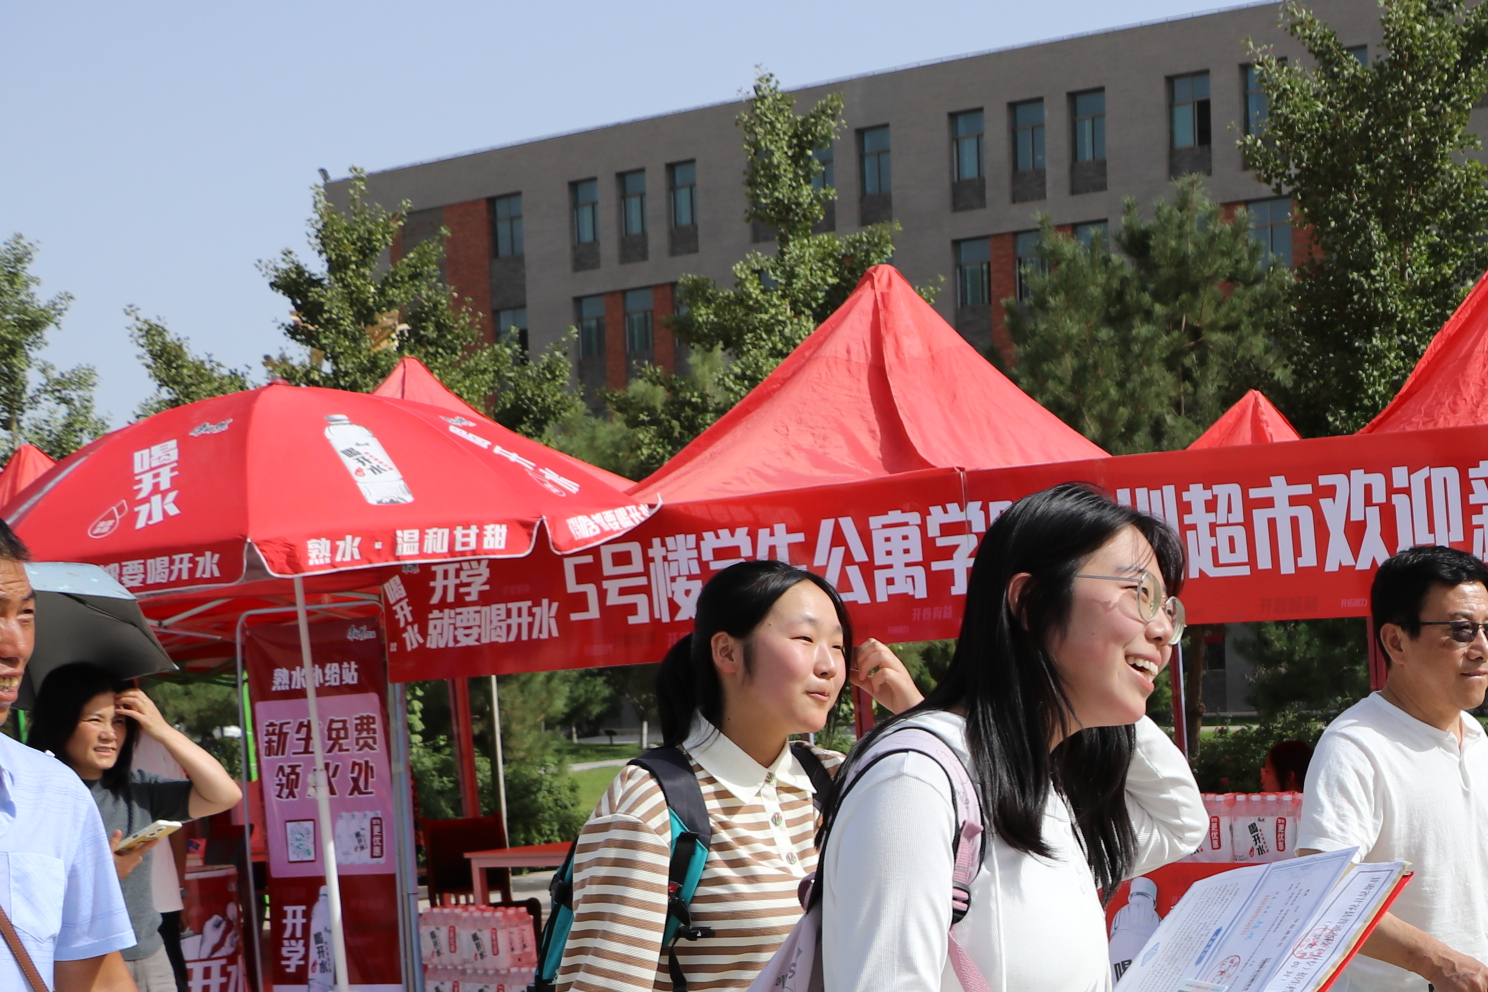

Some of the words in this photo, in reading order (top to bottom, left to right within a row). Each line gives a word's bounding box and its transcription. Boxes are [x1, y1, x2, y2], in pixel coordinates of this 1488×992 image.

[133, 439, 181, 530] 喝开水
[429, 560, 491, 604] 开学
[383, 575, 424, 652] 喝开水
[426, 598, 559, 649] 就要喝开水
[264, 714, 379, 757] 新生免费
[281, 905, 306, 973] 开学
